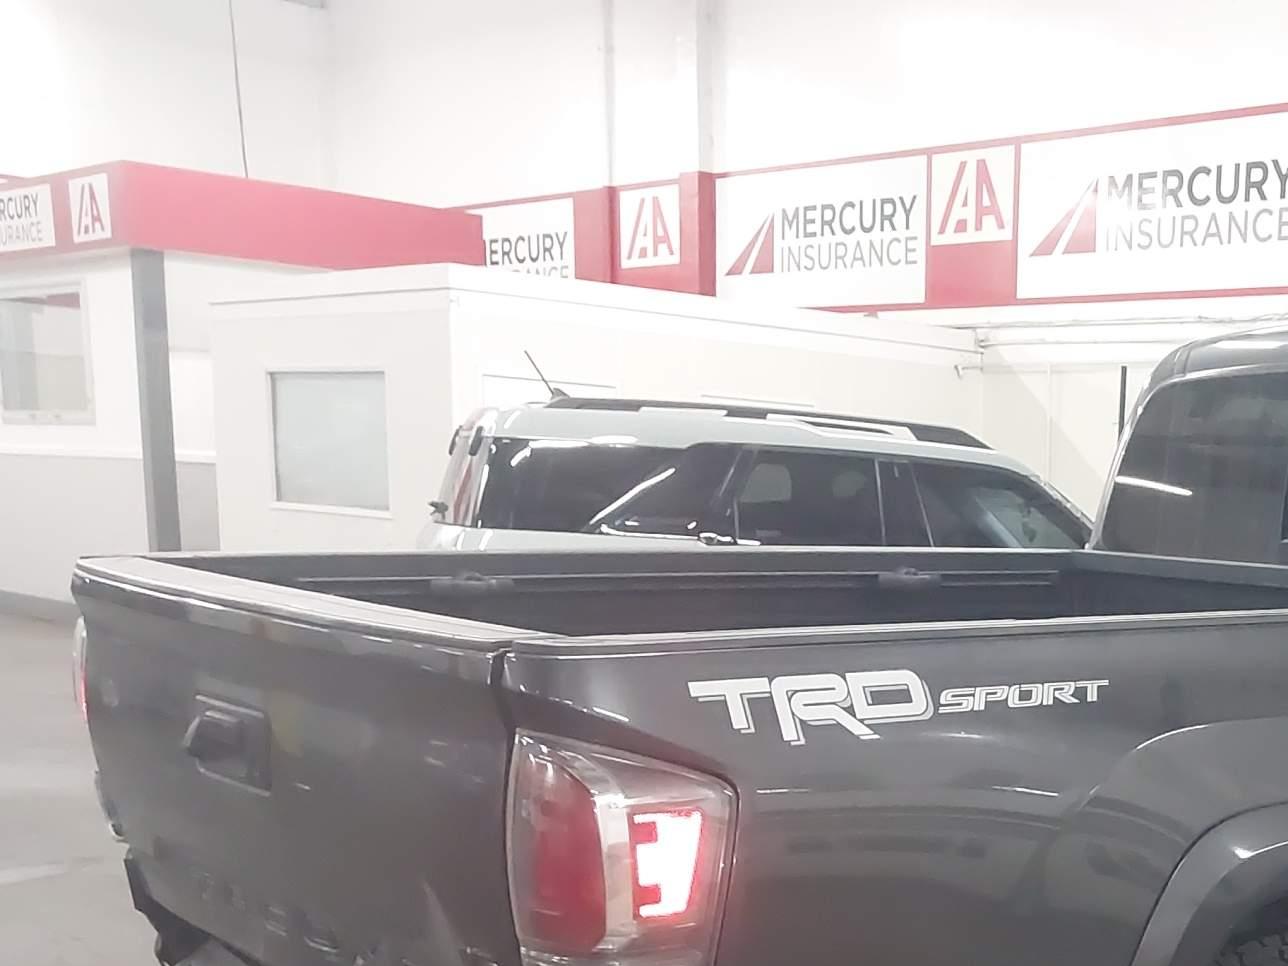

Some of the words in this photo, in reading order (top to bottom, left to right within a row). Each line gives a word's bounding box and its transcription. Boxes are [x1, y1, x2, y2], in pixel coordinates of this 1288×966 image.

[781, 195, 917, 240] MERCURY
[781, 236, 918, 273] INSURANCE
[688, 669, 934, 745] TRD
[938, 679, 1109, 713] SPORT
